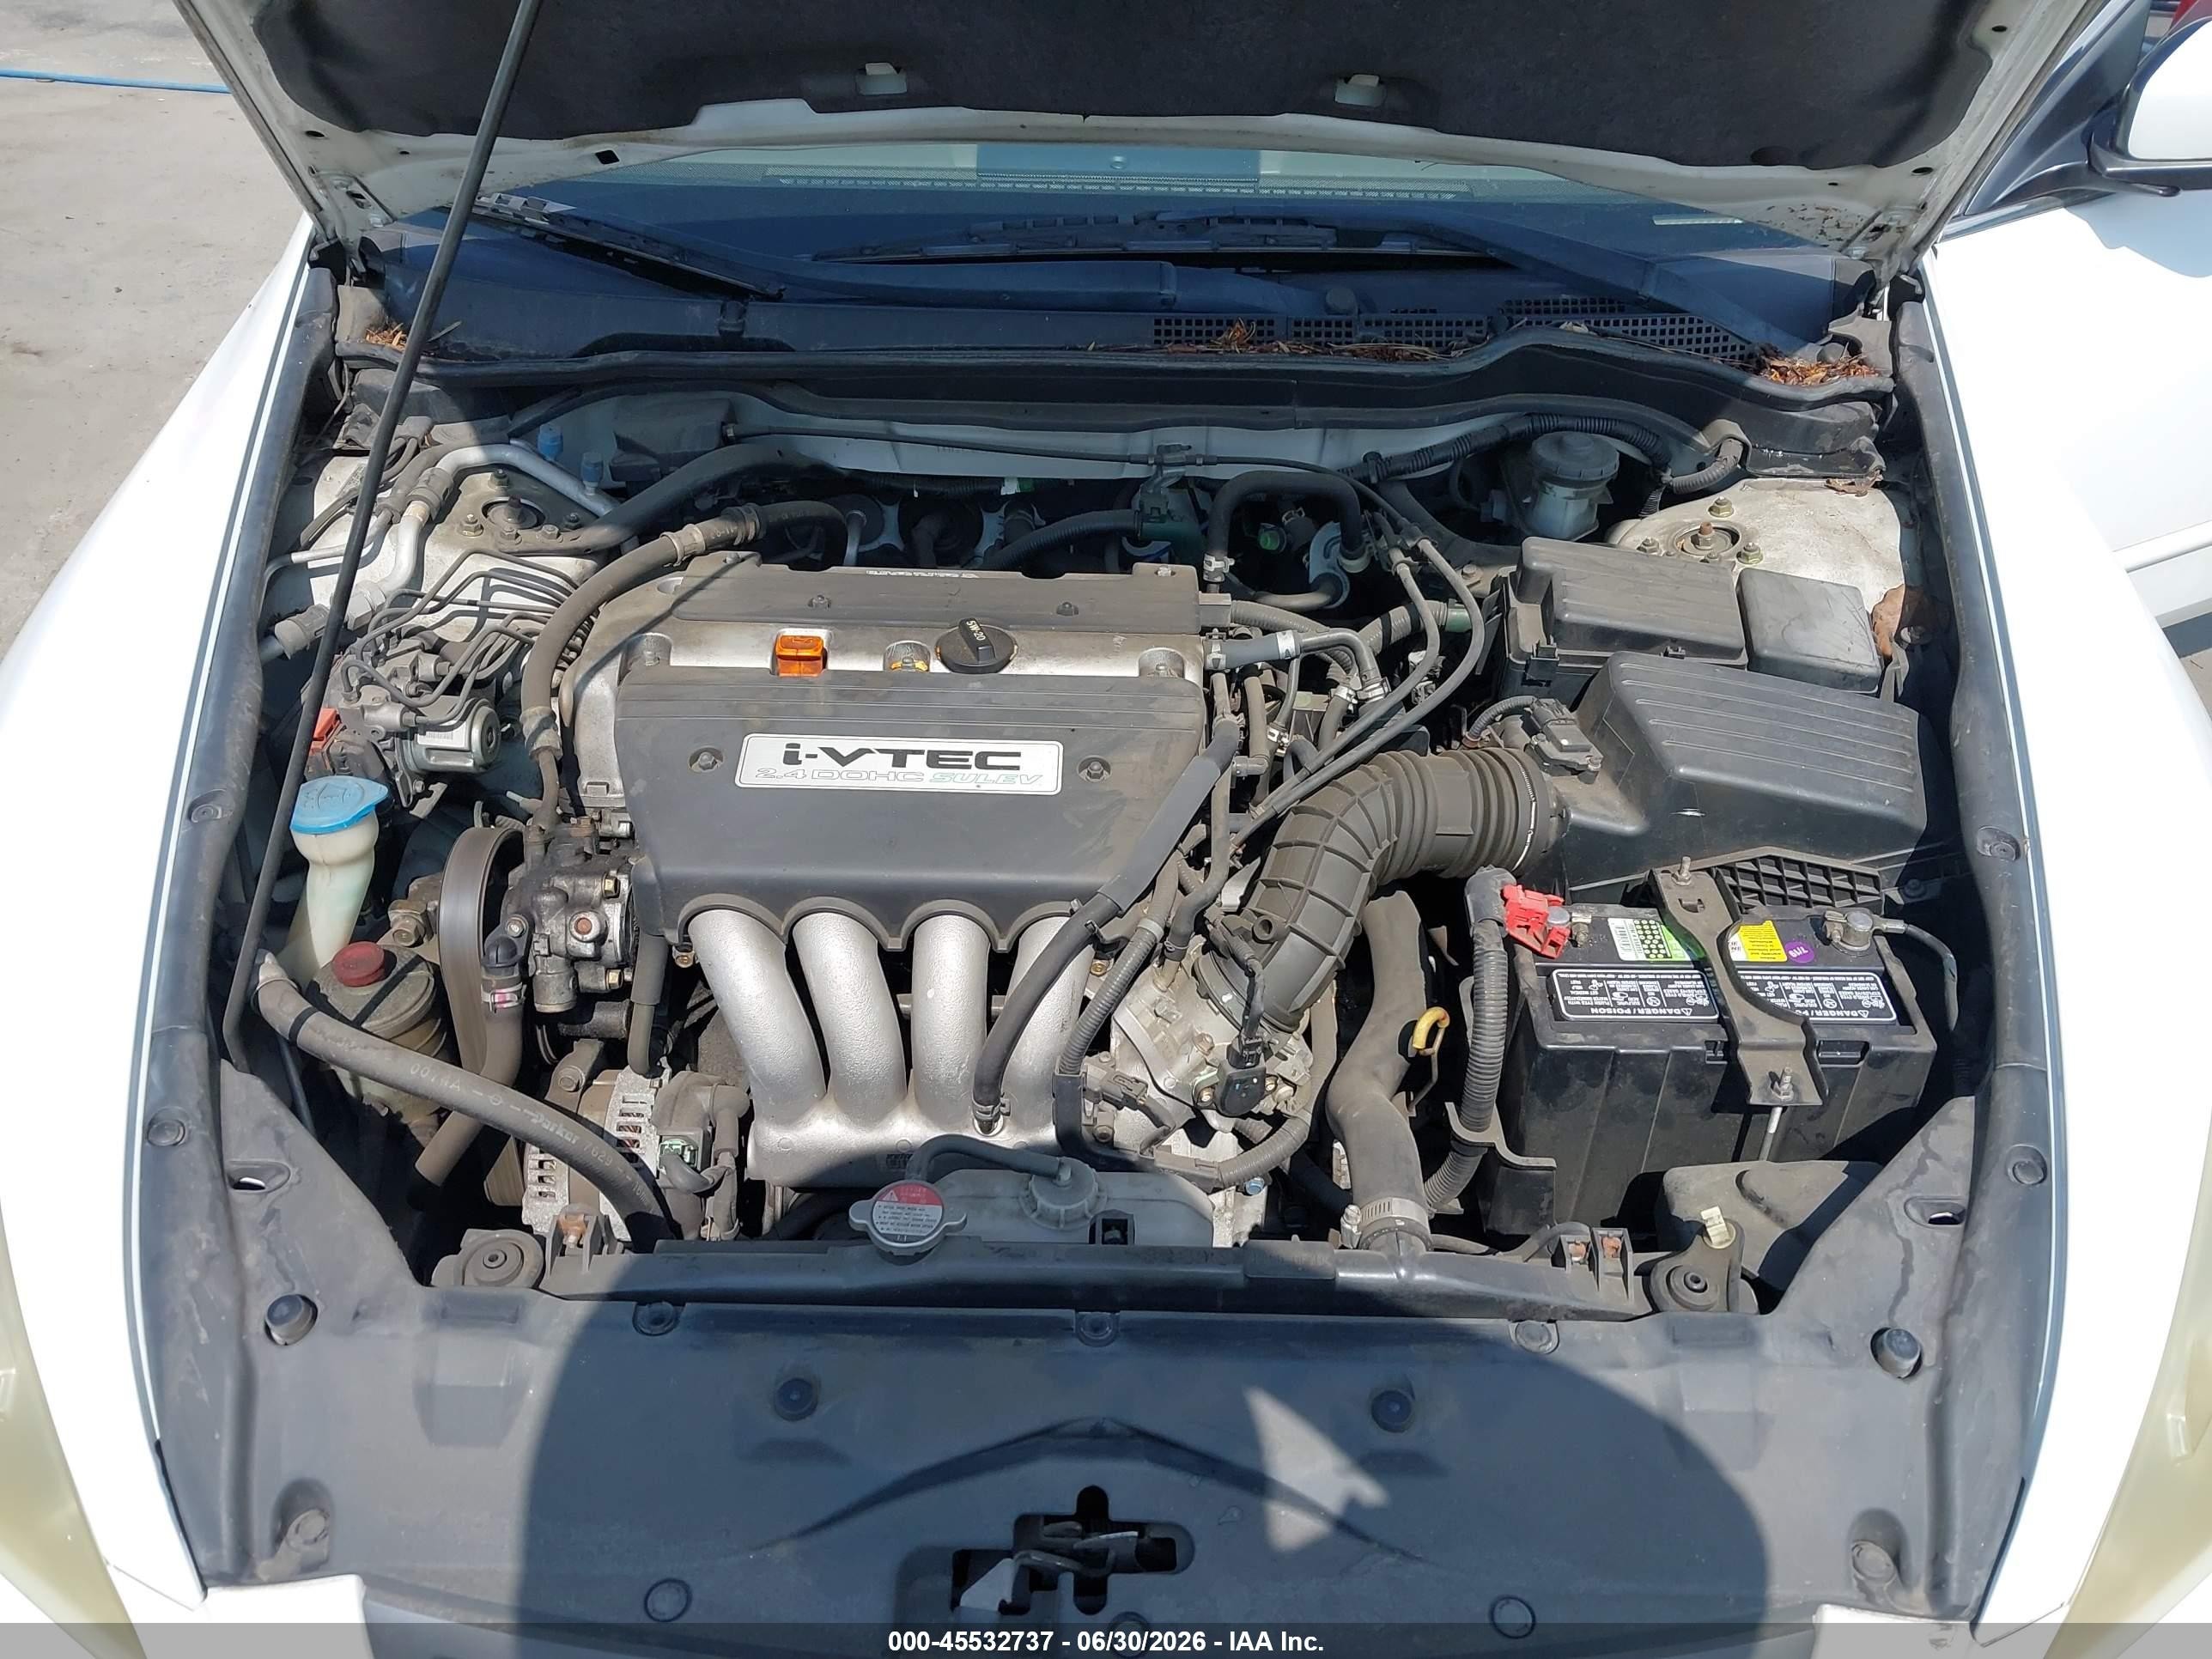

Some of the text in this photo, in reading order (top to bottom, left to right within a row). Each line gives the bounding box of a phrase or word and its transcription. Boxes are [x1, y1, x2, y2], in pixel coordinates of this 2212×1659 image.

[966, 620, 986, 641] 5W-20
[782, 742, 1022, 771] i-VTEC
[811, 768, 925, 783] DOHC
[928, 773, 1044, 786] SULEV
